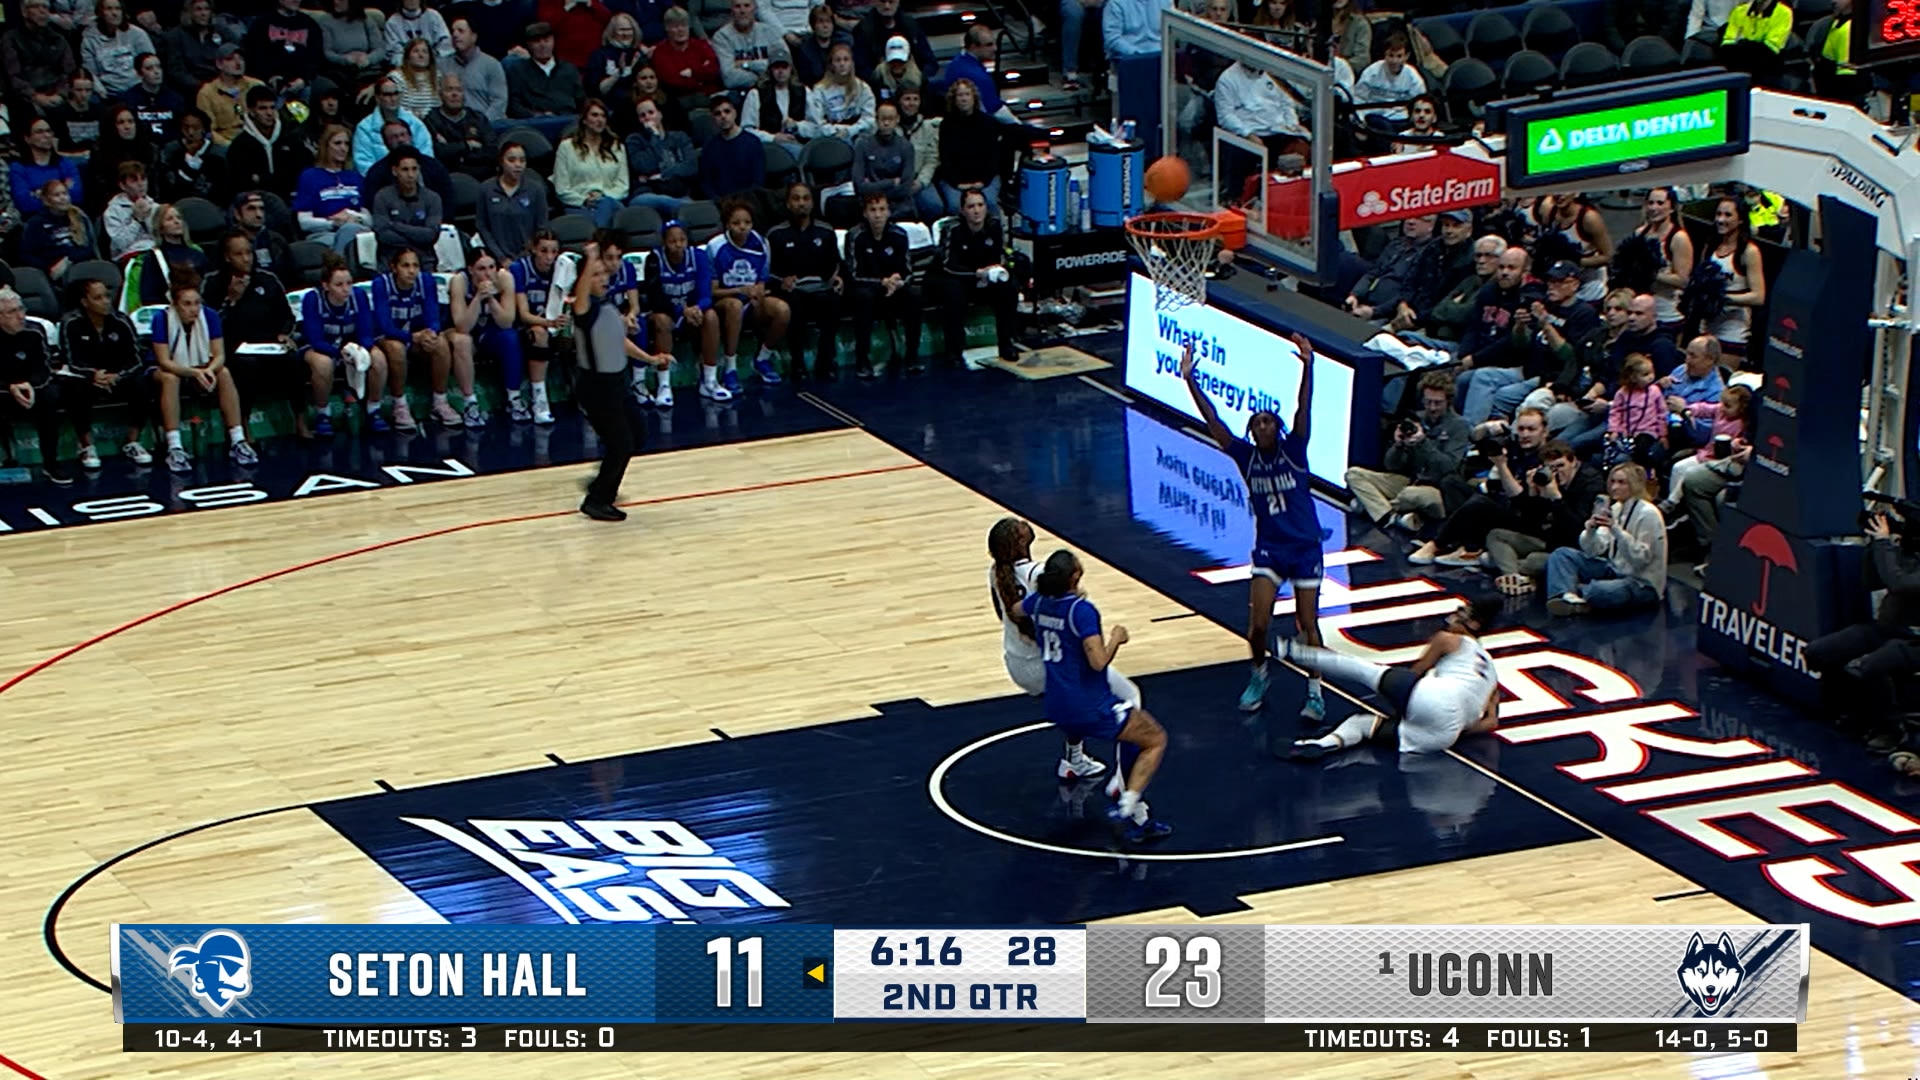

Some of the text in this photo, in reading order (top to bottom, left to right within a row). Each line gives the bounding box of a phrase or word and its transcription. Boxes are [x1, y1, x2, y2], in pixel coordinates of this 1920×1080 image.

[1568, 108, 1716, 150] DELTA DENTAL
[1055, 250, 1127, 270] POWERADE
[1158, 314, 1226, 366] What's in
[1156, 350, 1281, 414] you energy bill?
[1266, 492, 1287, 517] 21
[1042, 629, 1064, 663] 13
[466, 818, 701, 924] EAS
[573, 819, 793, 908] BIG
